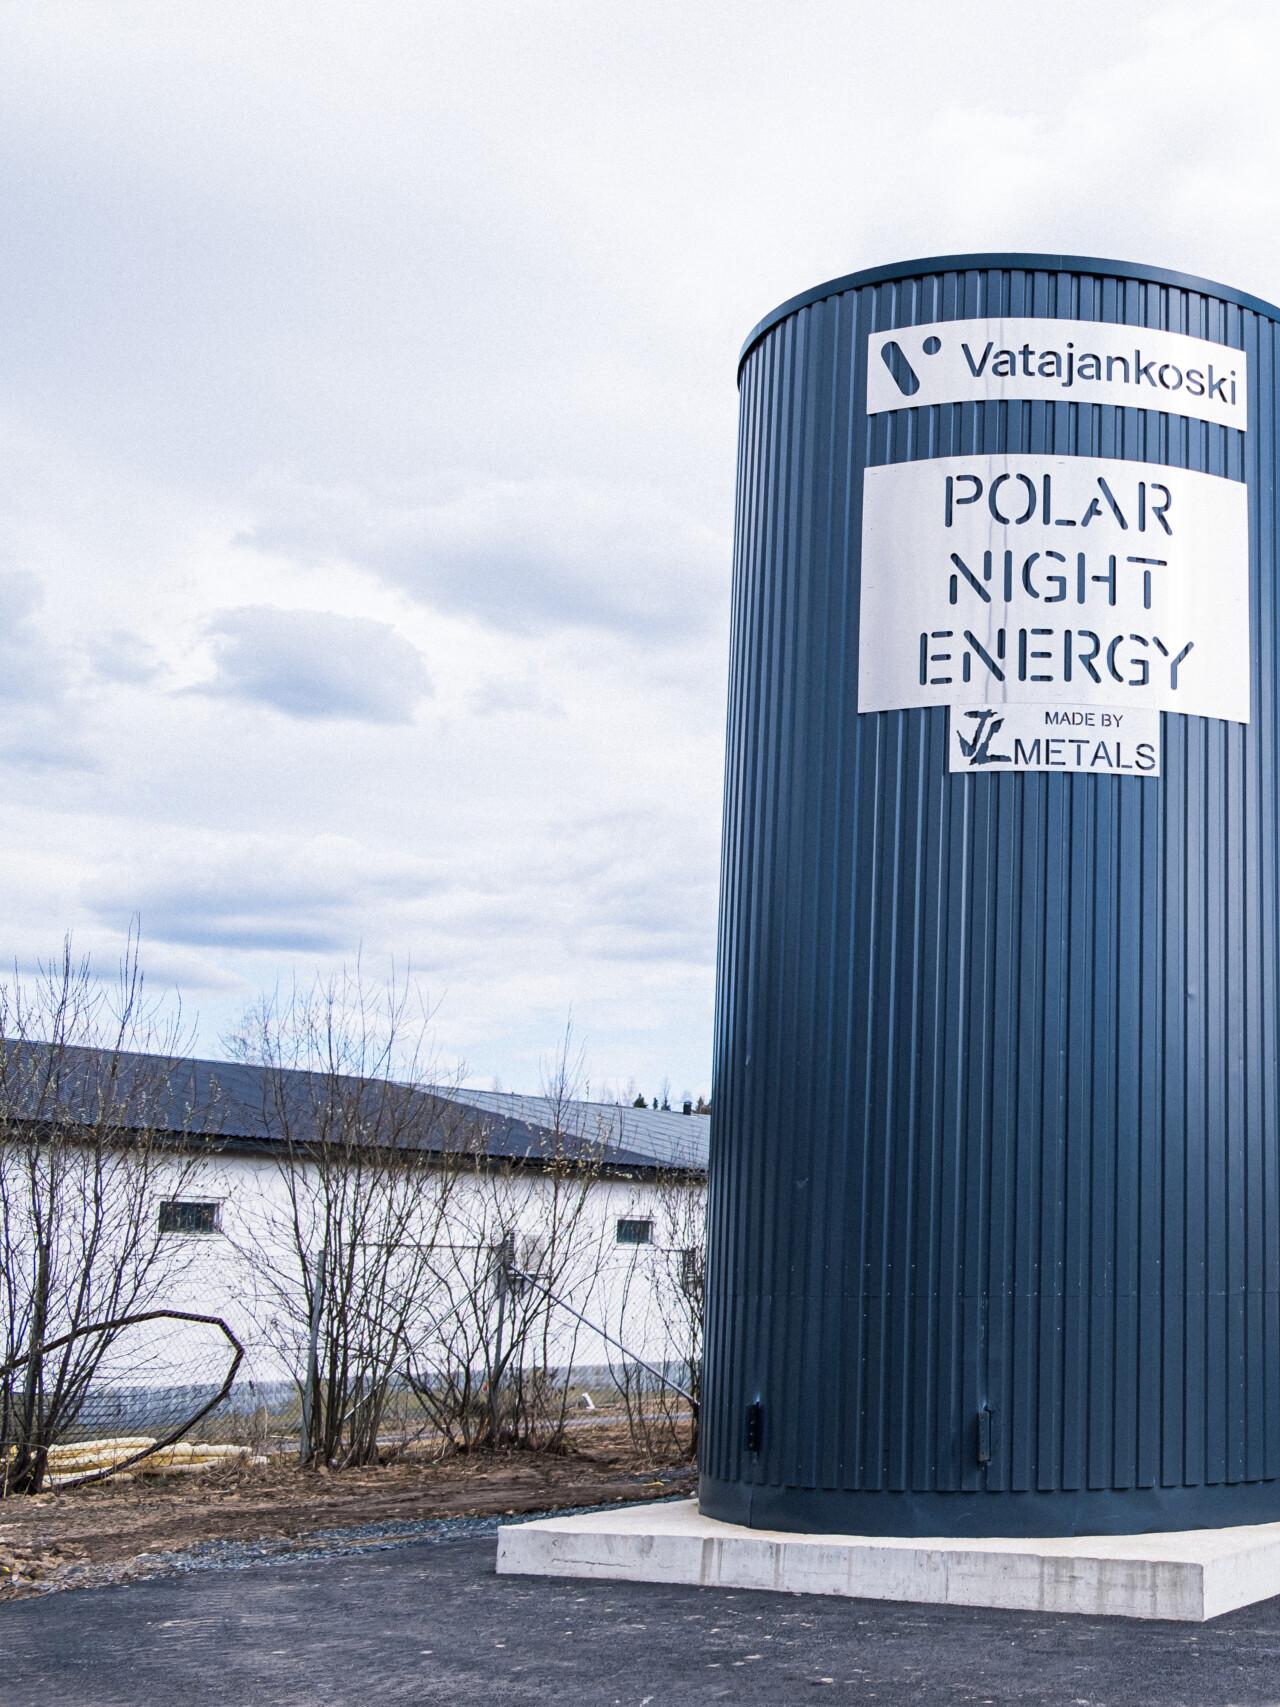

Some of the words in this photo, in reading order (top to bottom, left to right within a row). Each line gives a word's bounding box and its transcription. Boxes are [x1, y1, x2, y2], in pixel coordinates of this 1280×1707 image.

[961, 341, 1237, 406] Vatajankoski
[944, 472, 1173, 536] POLAR
[949, 550, 1168, 610] NIGHT
[919, 628, 1195, 690] ENERGY
[1044, 711, 1096, 727] MADE
[1101, 713, 1124, 728] BY
[1014, 738, 1156, 771] METALS
